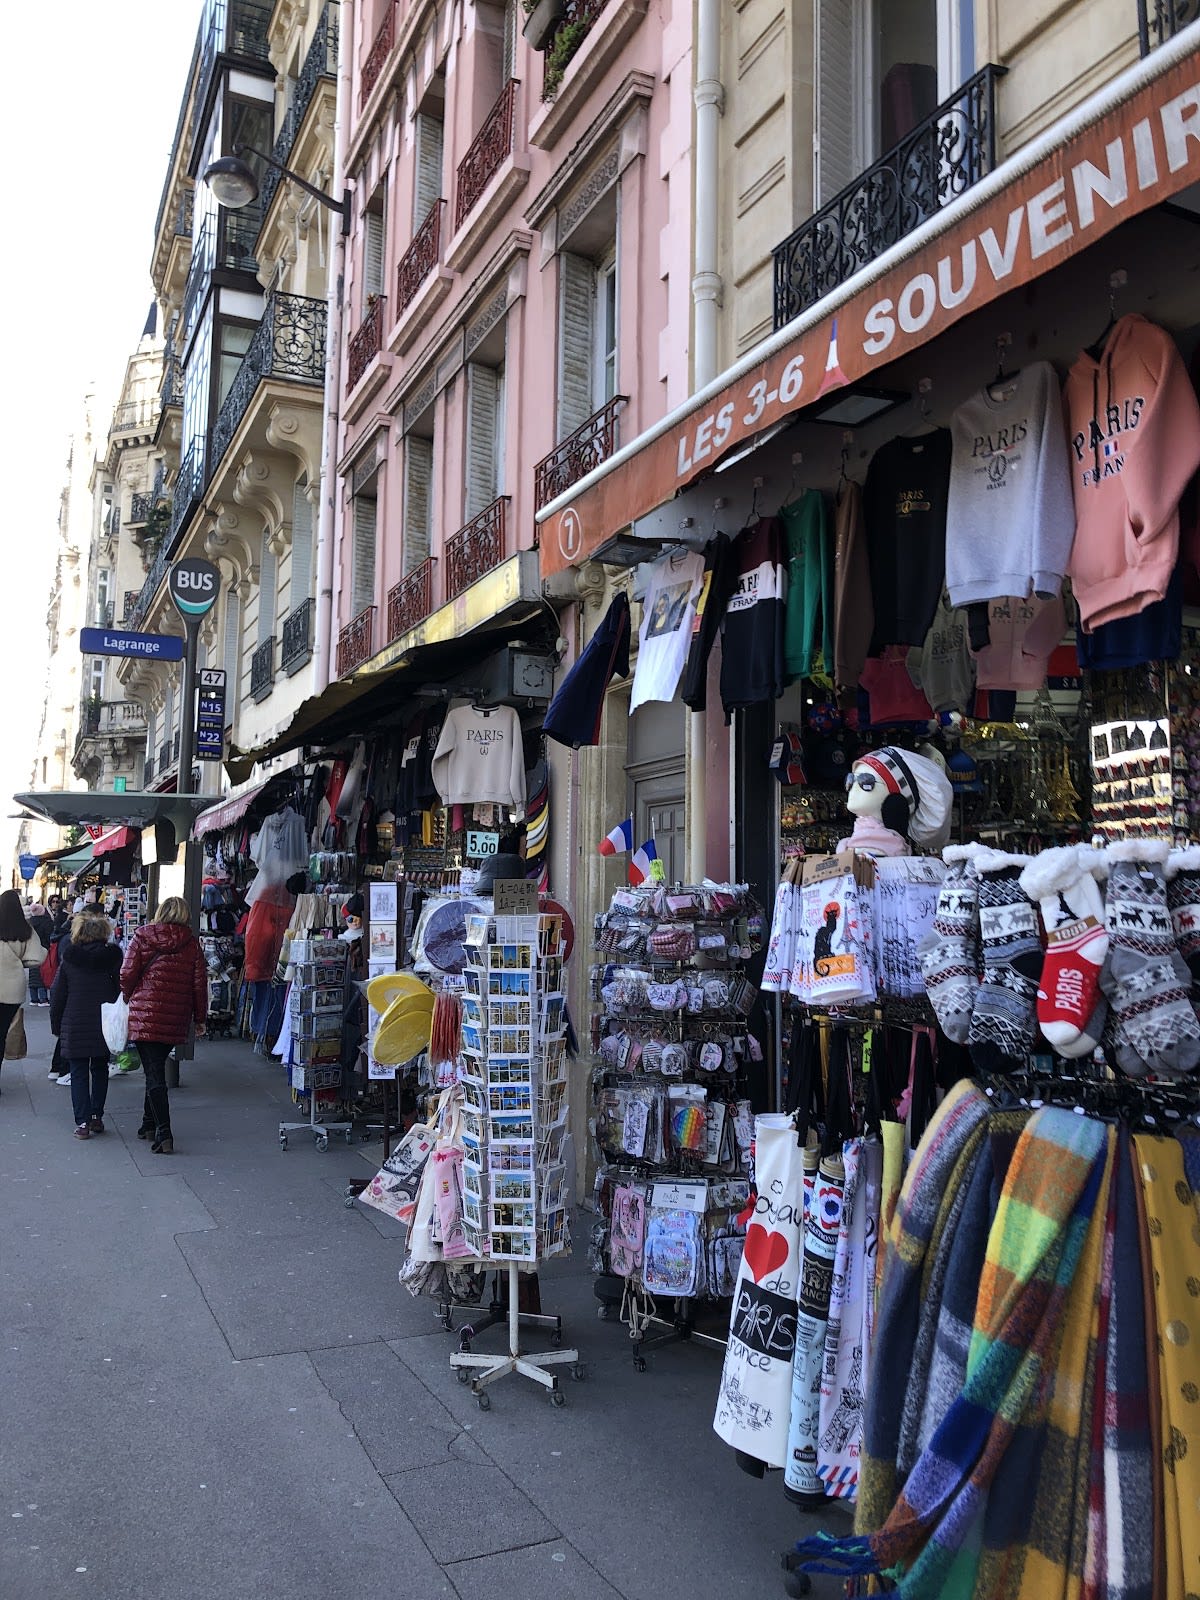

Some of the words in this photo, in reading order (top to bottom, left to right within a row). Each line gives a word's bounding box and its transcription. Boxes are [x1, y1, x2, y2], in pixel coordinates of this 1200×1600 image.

[861, 82, 1200, 356] SOUVENIR
[677, 401, 735, 477] LES
[742, 354, 806, 427] 3-6
[1071, 396, 1146, 462] PARIS
[970, 419, 1028, 458] PARIS
[177, 570, 214, 591] BUS
[103, 636, 160, 653] Lagrange
[203, 672, 222, 685] 47
[466, 729, 504, 741] PARIS
[469, 834, 496, 854] 5.00
[1054, 967, 1084, 1016] PARIS
[765, 1272, 792, 1296] de
[734, 1290, 799, 1350] PARIS
